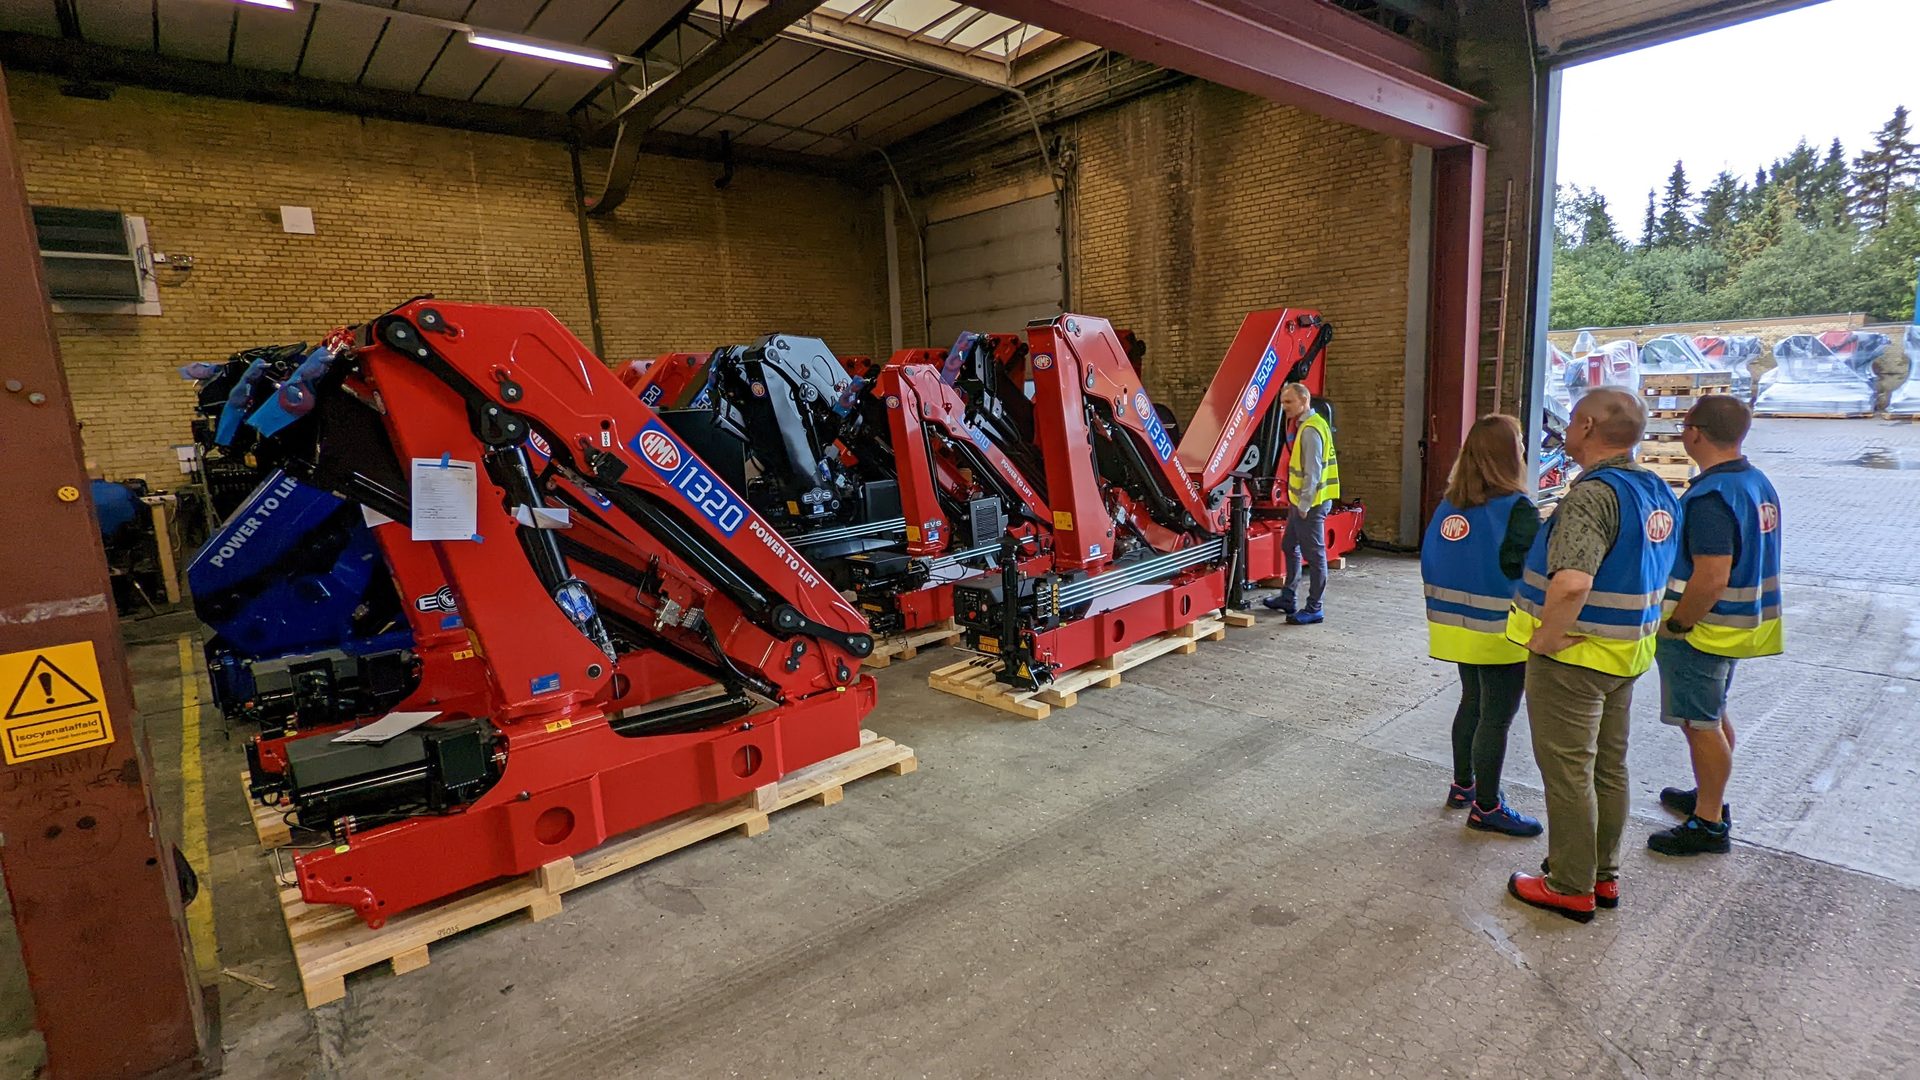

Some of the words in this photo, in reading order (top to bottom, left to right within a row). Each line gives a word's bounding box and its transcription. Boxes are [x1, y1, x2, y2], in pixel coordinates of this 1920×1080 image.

[1246, 386, 1259, 409] HMF
[1257, 350, 1277, 386] 5020
[1147, 416, 1172, 461] 1330
[1210, 440, 1229, 473] POWER
[1226, 428, 1235, 441] TO
[1232, 407, 1245, 429] LIFT
[643, 433, 678, 466] HMF
[678, 466, 744, 532] 1320
[1001, 459, 1018, 480] POWER
[1016, 477, 1024, 487] TO
[1173, 455, 1187, 481] POWER
[1185, 478, 1192, 490] TO
[803, 490, 832, 503] EVS
[209, 517, 263, 568] POWER
[255, 497, 280, 517] TO
[924, 520, 942, 529] EVS
[1442, 518, 1466, 538] HMF
[1648, 512, 1671, 539] HMF
[1760, 505, 1776, 531] MF
[748, 520, 786, 559] POWER
[784, 553, 800, 571] TO
[797, 567, 820, 589] LIFT
[16, 720, 98, 741] Isocyanataffald
